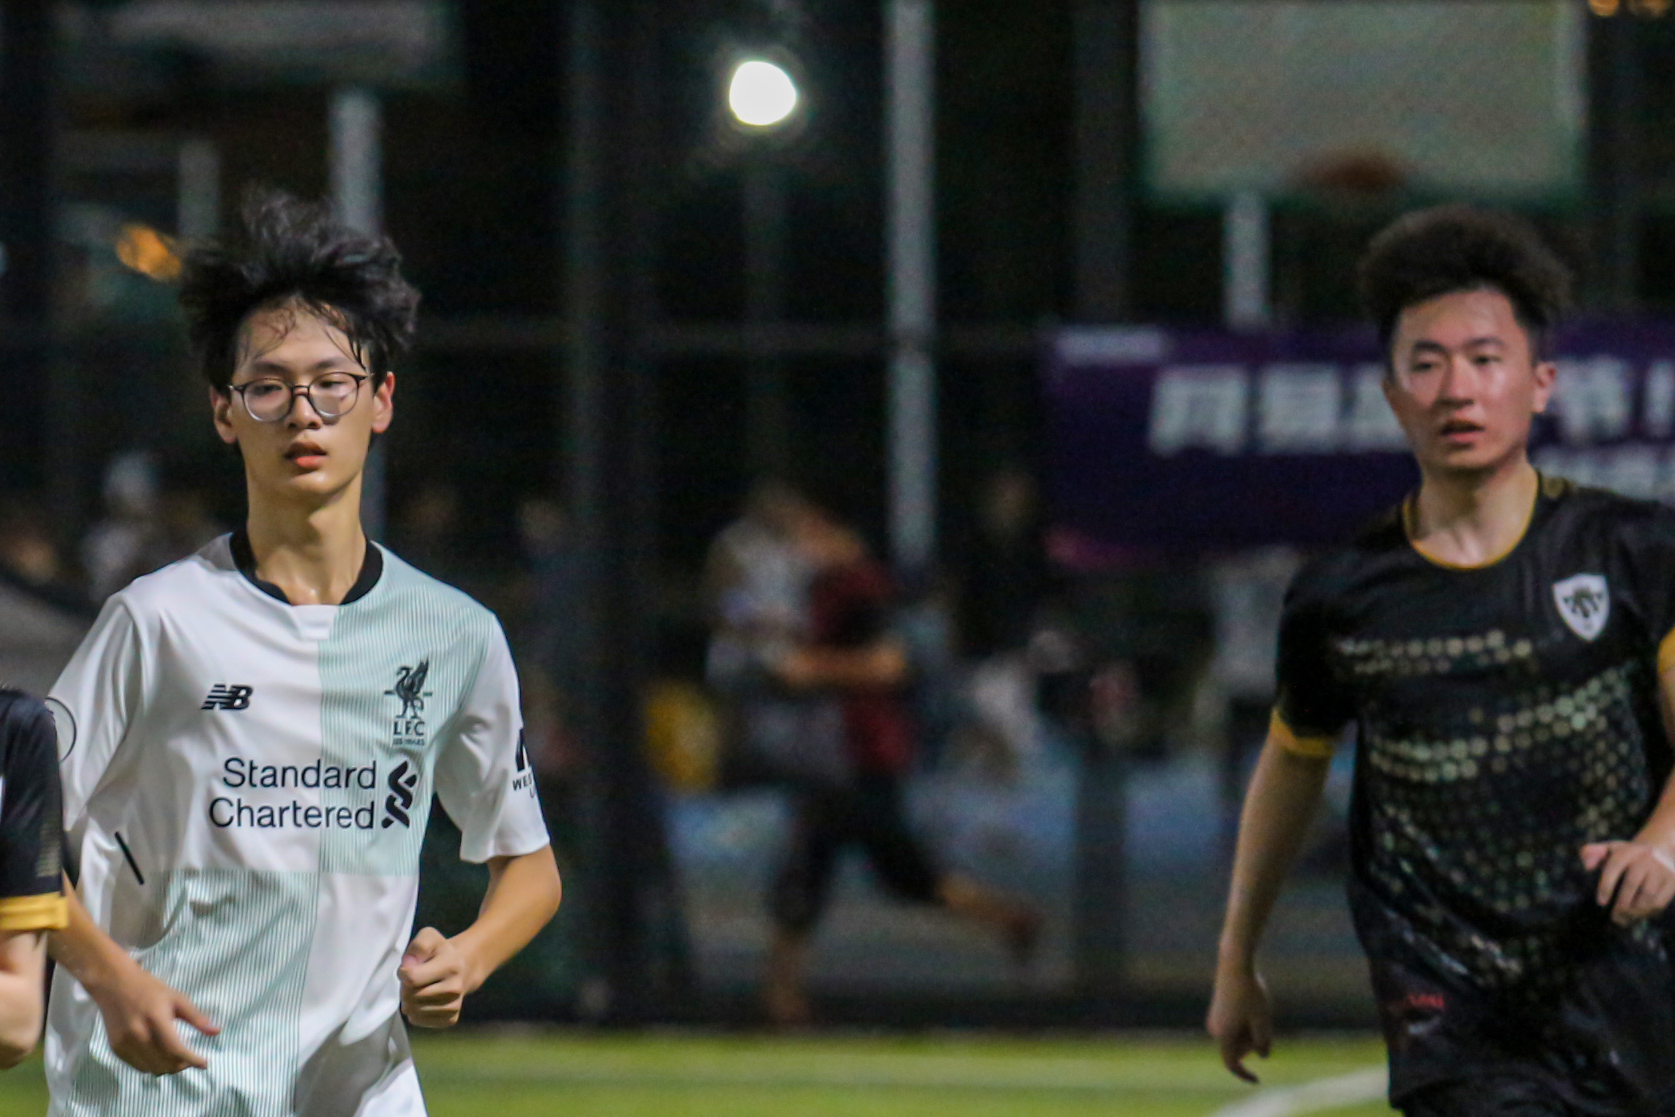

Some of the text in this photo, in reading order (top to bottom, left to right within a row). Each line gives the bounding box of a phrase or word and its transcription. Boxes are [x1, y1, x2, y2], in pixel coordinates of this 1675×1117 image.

[393, 721, 426, 737] LFC
[223, 757, 376, 789] Standard
[209, 797, 375, 829] Chartered
